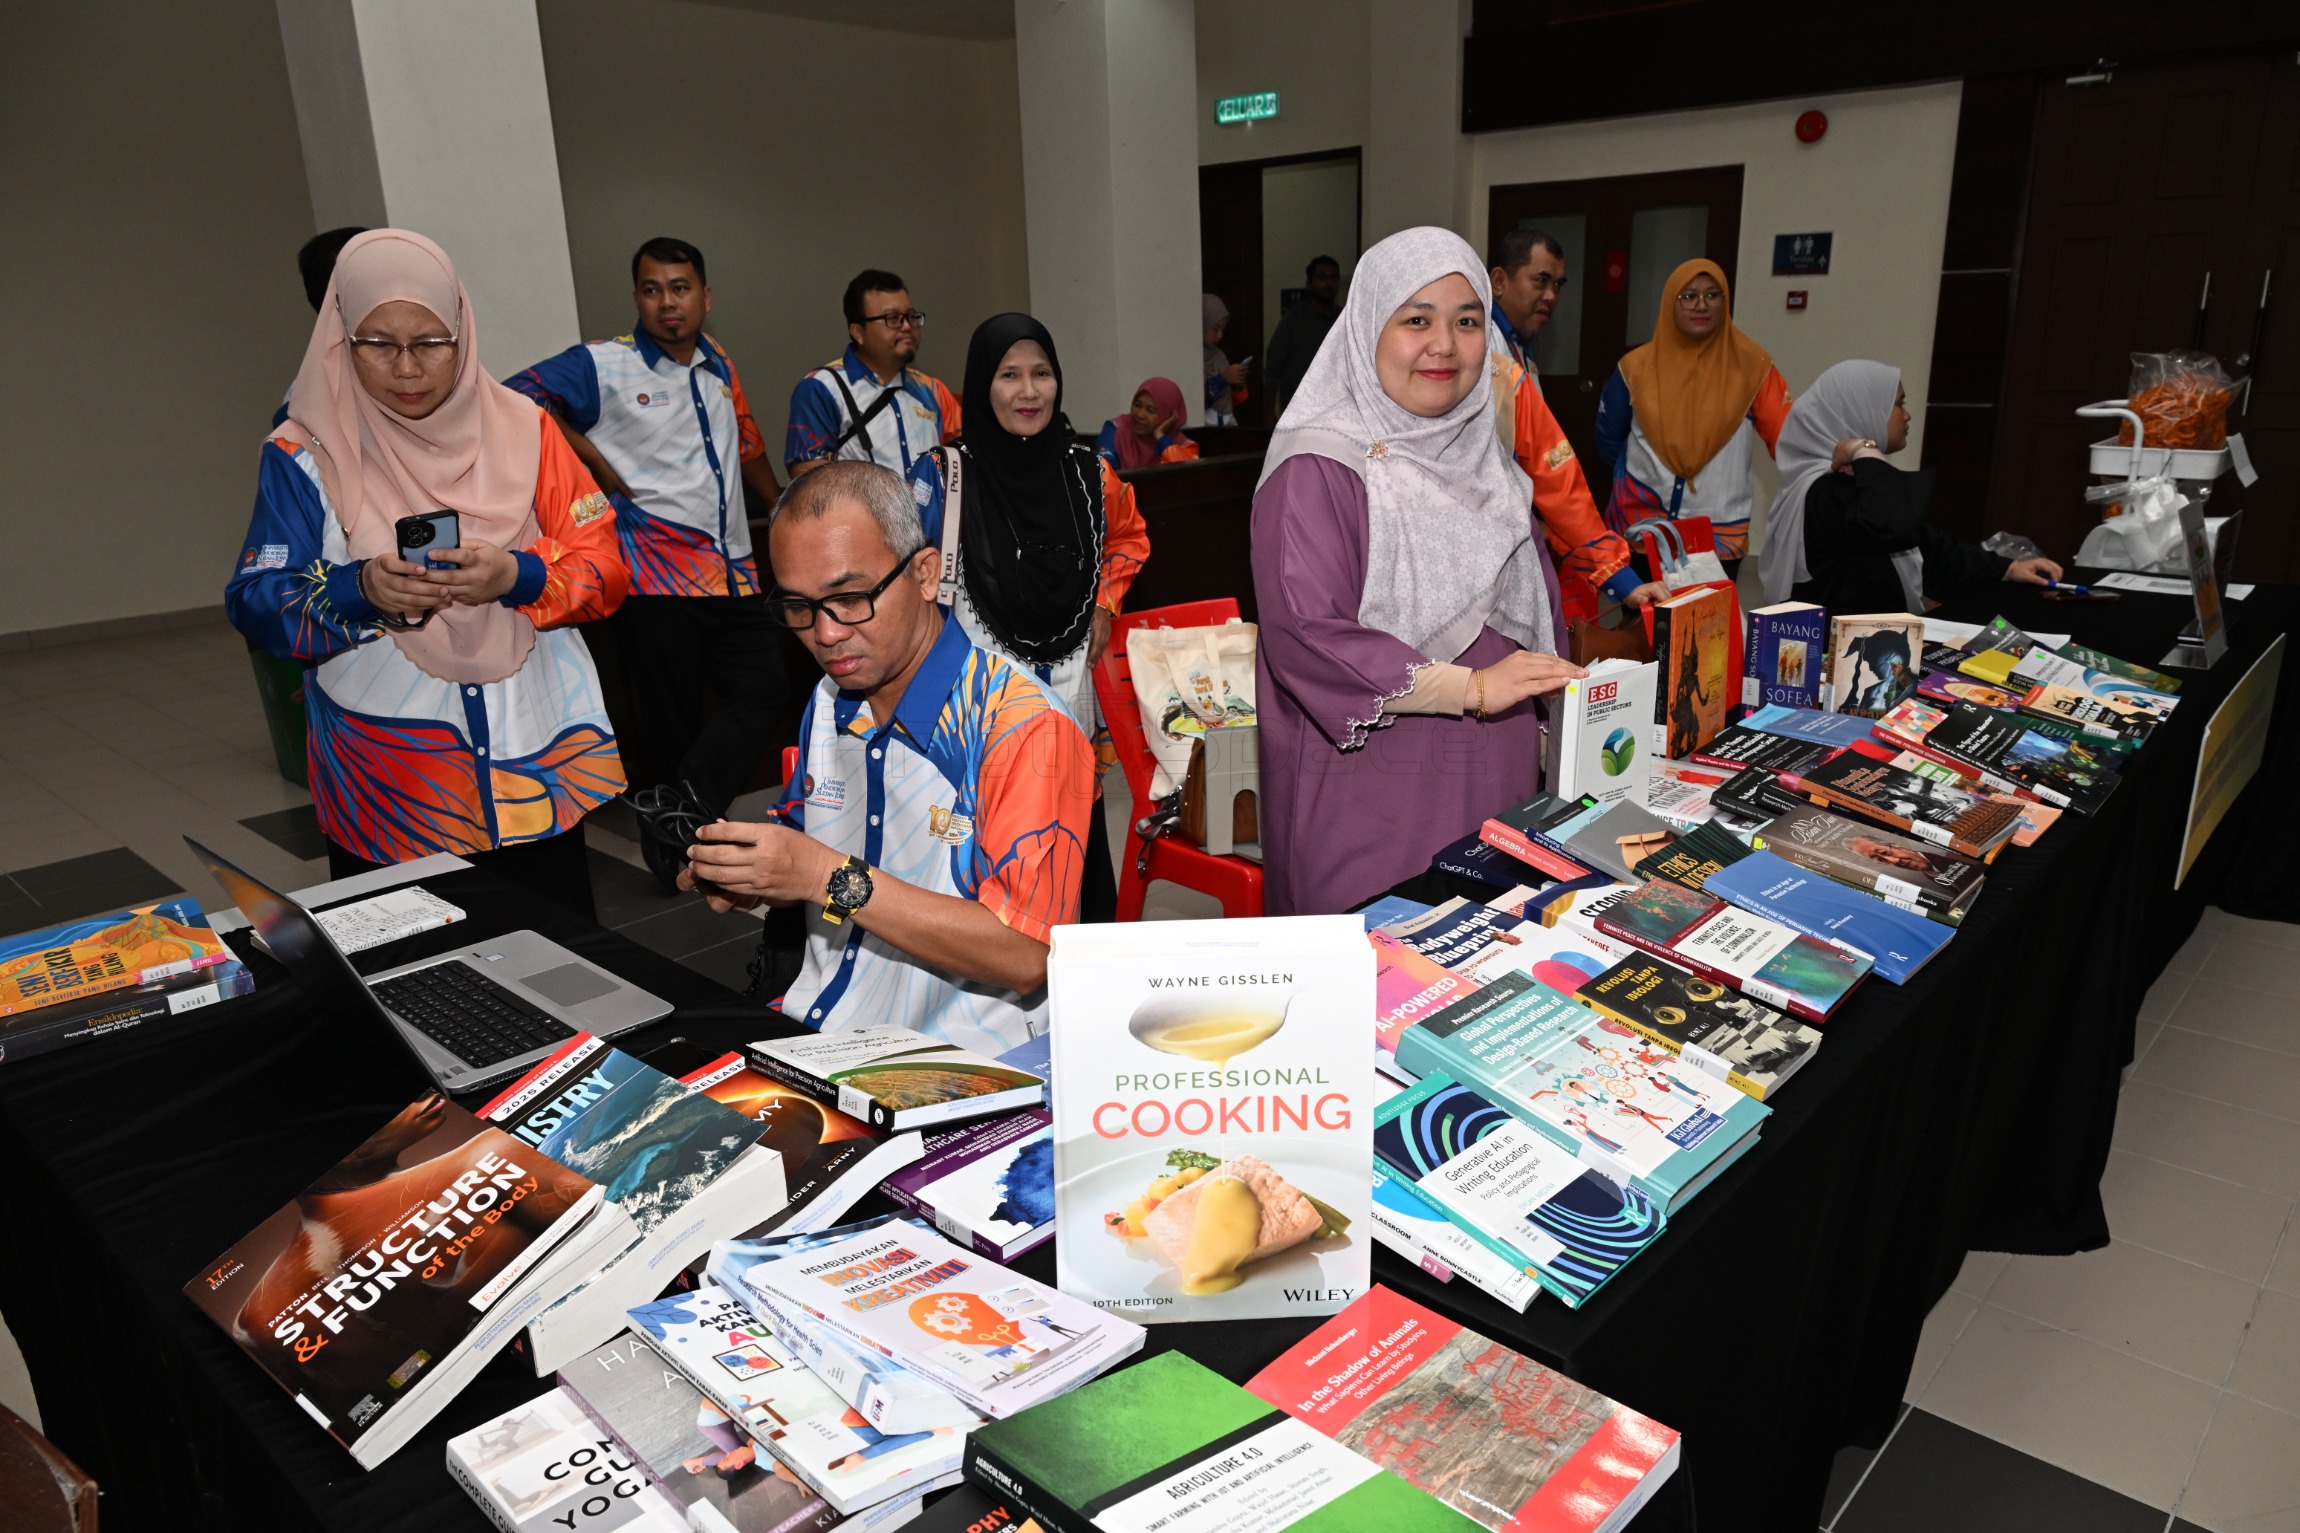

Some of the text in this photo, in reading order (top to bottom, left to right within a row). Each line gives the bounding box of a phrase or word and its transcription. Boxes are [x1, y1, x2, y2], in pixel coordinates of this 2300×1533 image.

[1218, 94, 1264, 120] KELUAR
[1772, 621, 1820, 639] BAYANG
[1587, 699, 1617, 710] LEADERSHIP
[1590, 683, 1616, 702] ESG
[1594, 706, 1610, 716] PUBLIC
[1611, 702, 1632, 711] SECTORS
[1766, 688, 1813, 706] SOFEA
[1488, 832, 1526, 856] ALGEBRA
[1440, 861, 1483, 879] ChatGPT & Co.
[1657, 853, 1699, 878] ETHICS
[1412, 908, 1501, 955] Bodyweight
[1692, 930, 1711, 946] FEMINIST
[1710, 922, 1723, 936] PEACE
[1723, 916, 1734, 927] AND
[1736, 894, 1754, 906] ETHICS
[1769, 909, 1779, 917] AGE
[1786, 917, 1810, 933] PERVASIVE
[1424, 925, 1505, 964] Blueprint
[1603, 922, 1622, 936] FEMINIST
[1622, 930, 1636, 942] PEACE
[1636, 935, 1645, 944] AND
[1645, 939, 1654, 948] THE
[1654, 942, 1674, 957] VIOLENCE
[1674, 951, 1680, 959] OF
[1680, 953, 1712, 972] COMMUNALISM
[1711, 935, 1722, 946] THE
[1722, 924, 1741, 940] VIOLENCE
[1720, 946, 1730, 955] OF
[1727, 927, 1756, 949] COMMUNALISM
[44, 948, 84, 990] BERFIKIR
[101, 952, 127, 975] HILANG
[196, 957, 213, 966] JAMIL
[1633, 966, 1658, 985] TANPA
[1148, 972, 1294, 989] WAYNE GISSLEN
[1596, 968, 1636, 993] REVOLUSI
[1625, 976, 1664, 1001] IDEOLOGI
[87, 1006, 144, 1027] Ensiklopedia:
[1376, 977, 1458, 1032] AI-POWERED
[1452, 988, 1514, 1025] Premier Research Source
[1460, 994, 1542, 1042] Global Perspectives
[93, 1020, 141, 1036] dalam Al-Quran
[1470, 995, 1563, 1056] and Implementations of
[1482, 1024, 1540, 1066] Design-Based
[1536, 1006, 1580, 1034] Research
[1615, 1018, 1664, 1048] REVOLUSI TANPA
[503, 1043, 596, 1115] 2025 RELEASE
[692, 1062, 746, 1091] RELEASE
[751, 1052, 767, 1064] Artificial
[767, 1059, 788, 1075] Intelligence
[795, 1071, 813, 1086] Precision
[813, 1080, 836, 1096] Agriculture
[1115, 1067, 1329, 1092] PROFESSIONAL
[1092, 1092, 1352, 1139] COOKING
[1378, 1090, 1426, 1120] ROUTLEDGE FOCUS
[1683, 1114, 1704, 1132] Global
[827, 1147, 856, 1172] ARNY
[1444, 1134, 1515, 1182] Generative AI in
[1454, 1142, 1533, 1195] Writing Education
[1395, 1173, 1443, 1212] Writing Education
[1480, 1157, 1542, 1201] Policy Pedagogical
[1504, 1174, 1538, 1198] Implications
[421, 1175, 538, 1280] of the Body
[268, 1199, 425, 1328] PATTON BELL THOMPSON WILLIAMSON
[274, 1151, 508, 1346] STRUCTURE
[294, 1162, 527, 1363] & FUNCTION
[800, 1239, 899, 1275] MEMBUDAYAKAN
[1371, 1212, 1483, 1284] CLASSROOM ANNE BONNYCASTLE
[206, 1259, 235, 1286] 17TH
[211, 1262, 245, 1291] EDITION
[818, 1247, 921, 1287] INOVASI
[842, 1258, 972, 1313] KREATIVITI
[844, 1259, 933, 1294] MELESTARIKAN
[765, 1284, 860, 1339] MEMBUDAYAKAN MELESTARIKAN
[1093, 1297, 1173, 1309] 10TH EDITION
[1283, 1289, 1354, 1302] WILEY
[757, 1293, 809, 1344] Methodology for Health
[1297, 1318, 1419, 1412] In the Shadow of Animals
[1304, 1327, 1358, 1367] Michael Hehenberger
[641, 1331, 728, 1409] PANDUAN AKTIVITI KANAK-KANAK
[1316, 1328, 1427, 1414] What Sapiens Can Learn by Studying
[1354, 1352, 1415, 1399] Other Living Beings
[358, 1402, 384, 1427] ELSEVIER
[976, 1456, 1023, 1496] AGRICULTURE 4.0
[1146, 1441, 1314, 1532] SMART FARMING WITH AND ARTIFICIAL INTELLIGENCE
[1166, 1447, 1264, 1499] AGRICULTURE 4.0
[458, 1468, 496, 1520] COMPLETE
